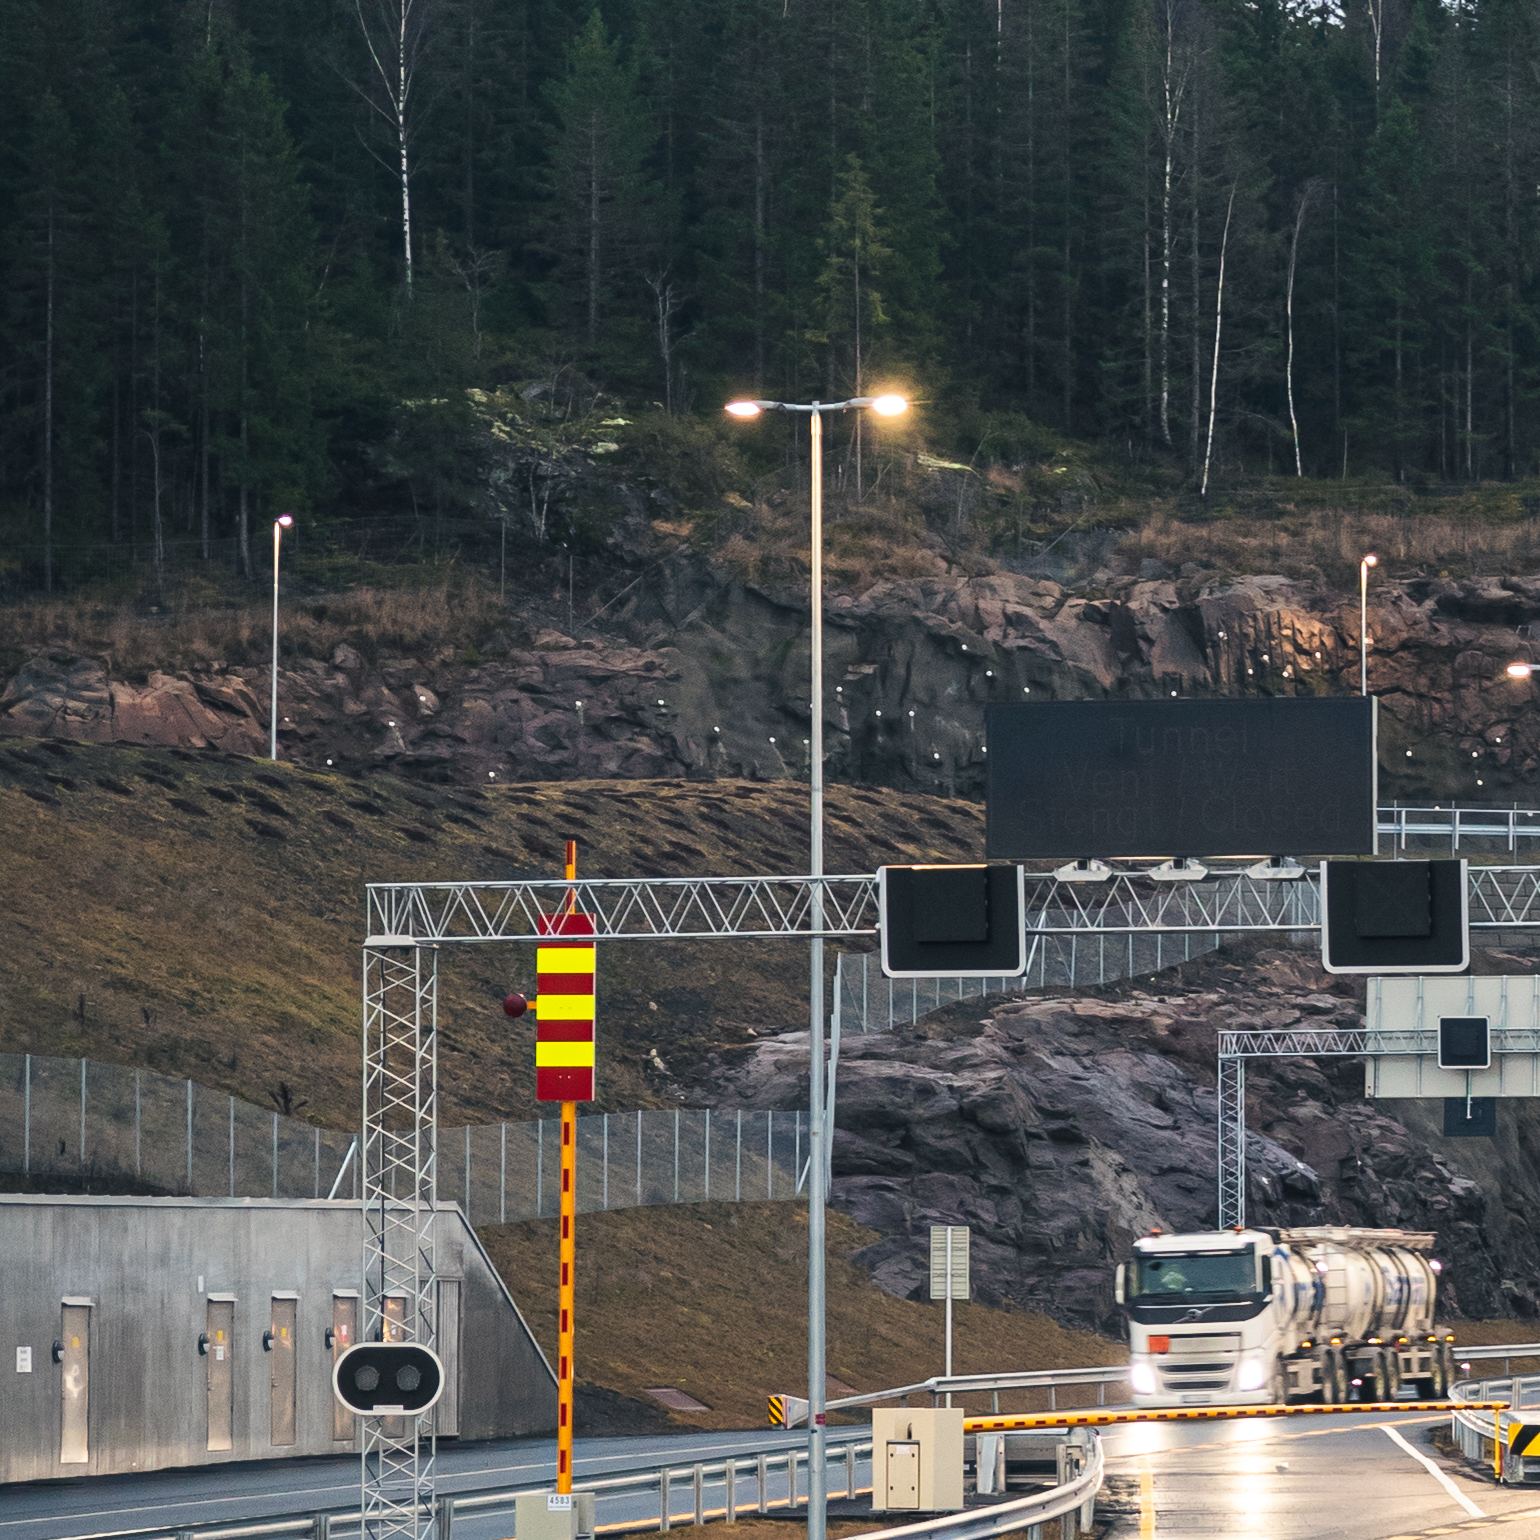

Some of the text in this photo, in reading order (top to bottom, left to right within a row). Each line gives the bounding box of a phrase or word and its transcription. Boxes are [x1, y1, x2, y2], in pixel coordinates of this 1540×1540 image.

[1109, 716, 1248, 756] Tunnel
[1063, 758, 1157, 798] Vent
[1017, 797, 1159, 845] Stengt
[1200, 795, 1343, 835] Closed
